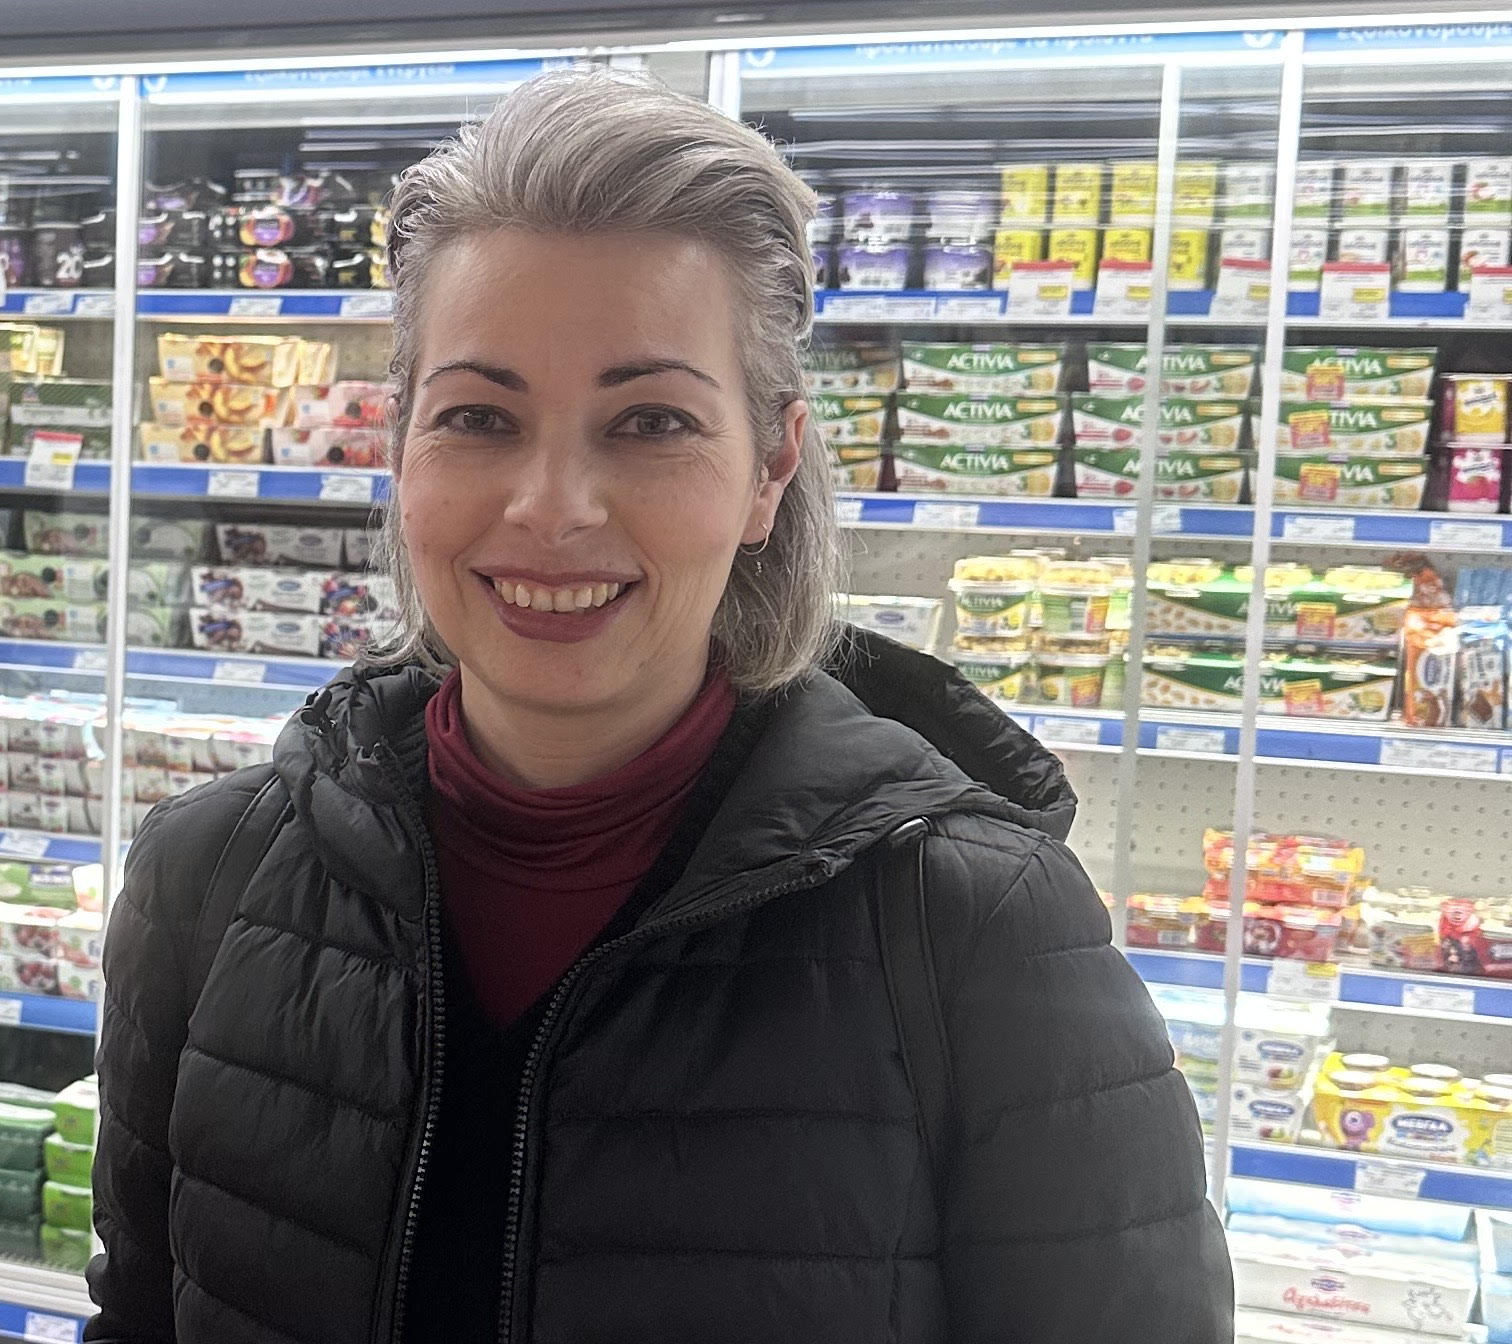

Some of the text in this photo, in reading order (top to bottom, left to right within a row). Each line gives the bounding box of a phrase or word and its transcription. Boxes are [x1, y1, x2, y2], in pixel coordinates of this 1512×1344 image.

[947, 352, 1014, 370] ACTIVIA
[943, 401, 1012, 419] ACTIVIA
[940, 452, 1008, 471] ACTIVIA
